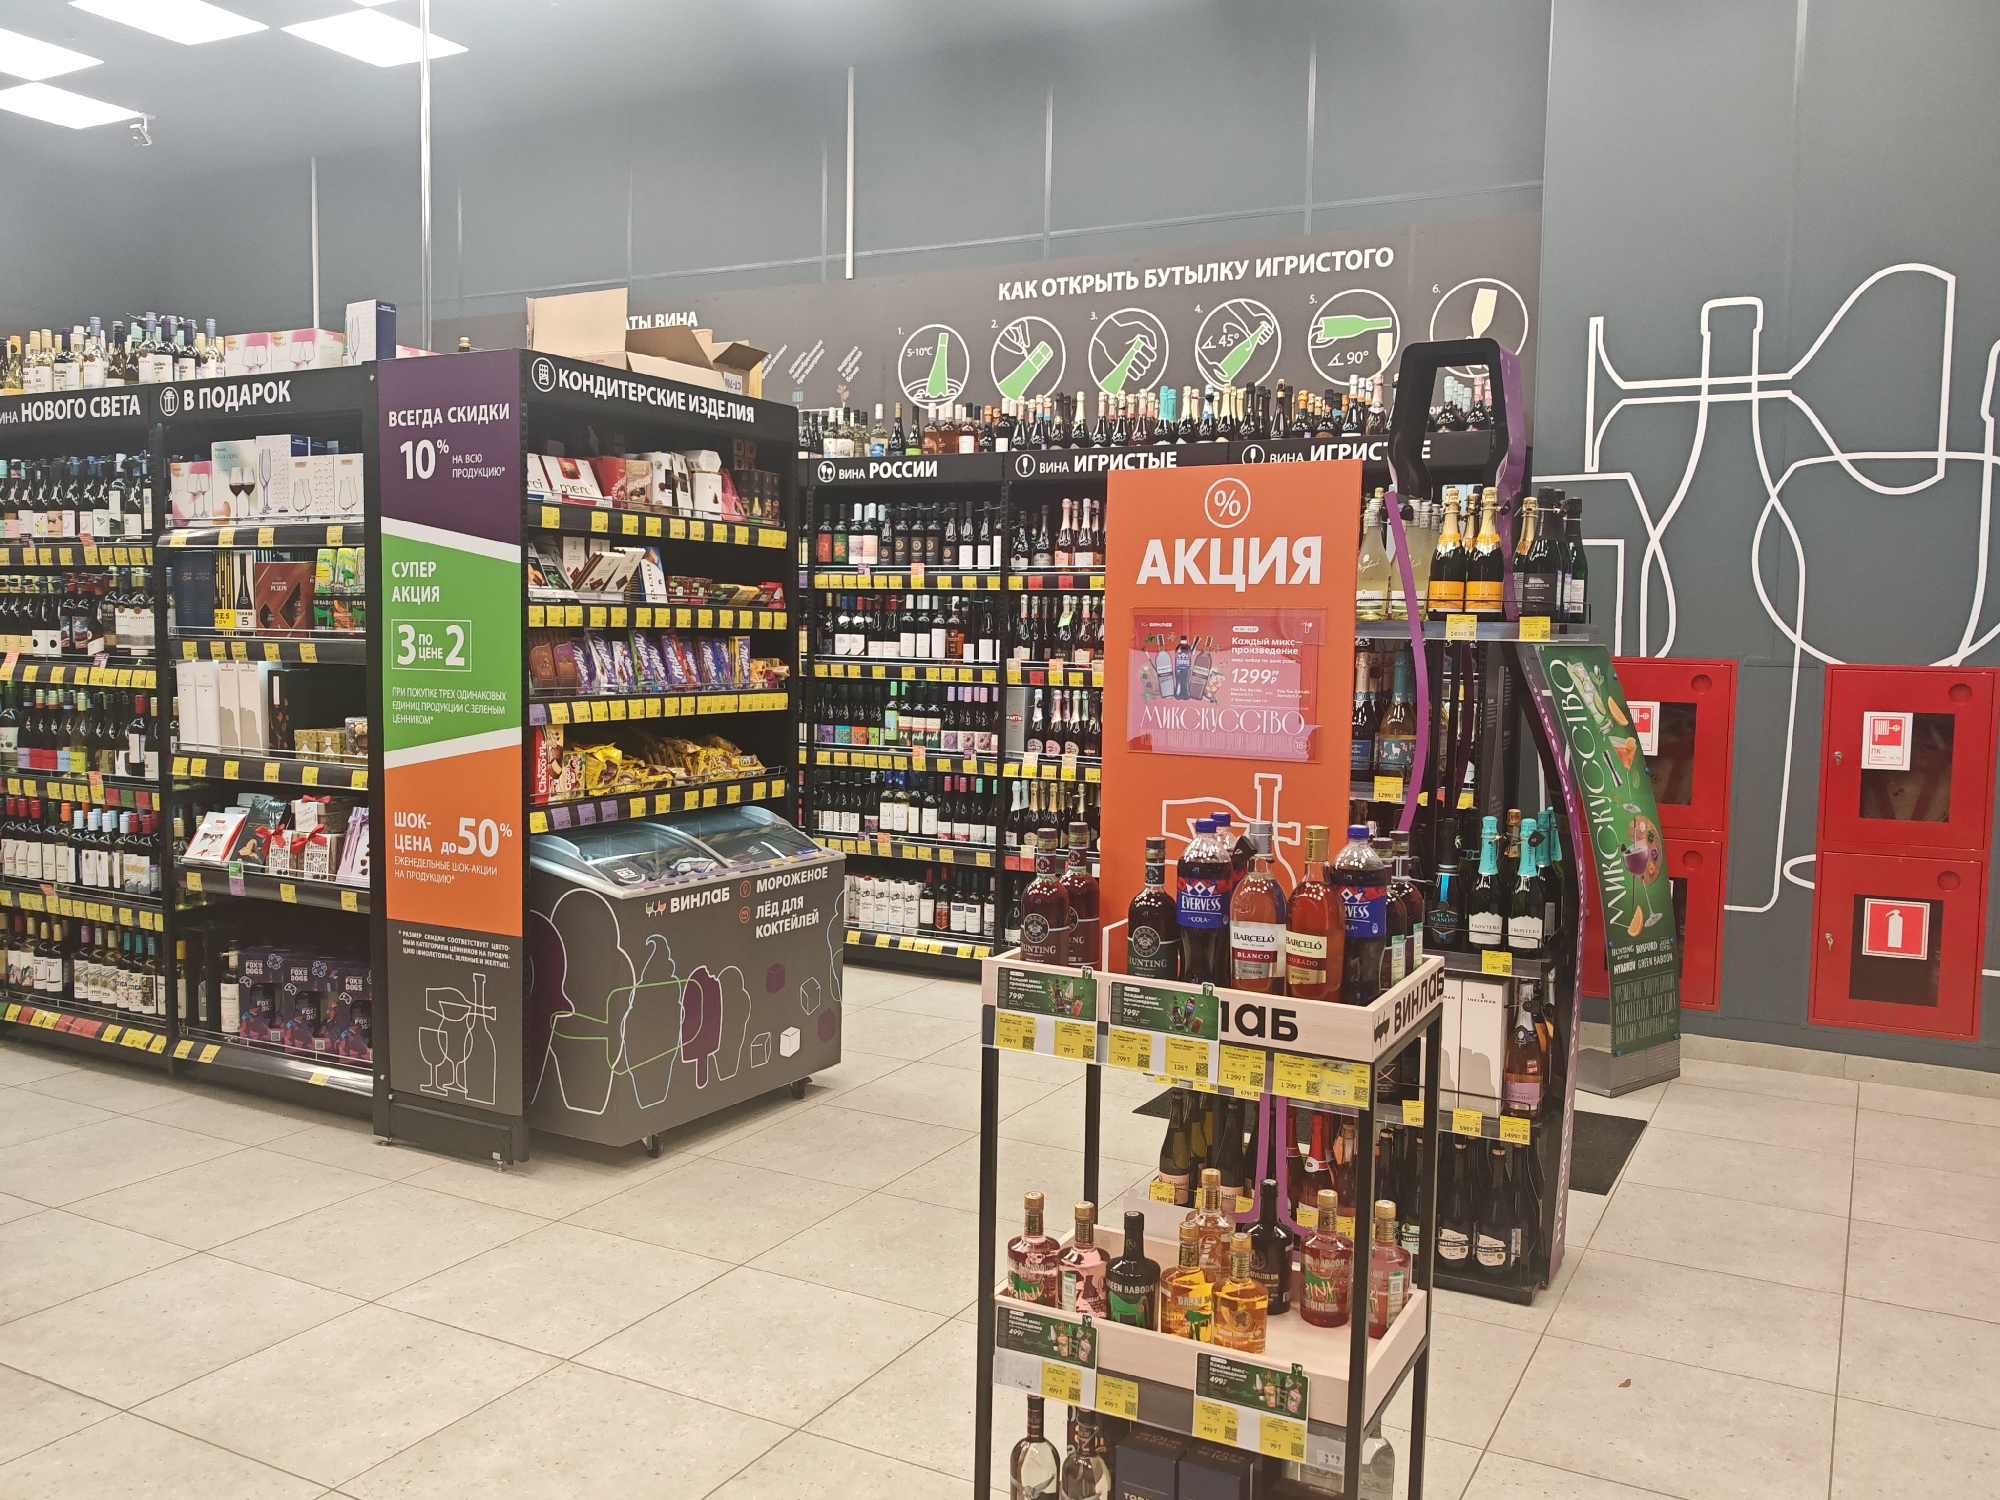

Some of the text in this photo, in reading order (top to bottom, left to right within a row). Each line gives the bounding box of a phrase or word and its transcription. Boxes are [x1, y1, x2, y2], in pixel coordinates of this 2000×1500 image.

[998, 246, 1394, 301] КАК ОТКРЫТЬ БУТЫЛКУ ИГРИСТОГО
[1432, 284, 1441, 294] 6.
[1309, 295, 1318, 304] 5.
[1090, 311, 1098, 320] 3.
[1194, 304, 1203, 314] 4.
[655, 311, 698, 328] ВИНА
[991, 320, 998, 328] 2.
[897, 327, 905, 336] 1.
[1218, 332, 1240, 348] 45°
[1346, 350, 1369, 366] 90°
[183, 379, 291, 413] В ПОДАРОК
[558, 368, 686, 412] КОНДИТЕРСКИЕ
[688, 393, 755, 424] ИЗДЕЛИЯ
[21, 399, 87, 423] НОВОГО
[90, 394, 141, 418] СВЕТА
[388, 403, 510, 429] ВСЕГДА СКИДКИ
[400, 438, 450, 480] 10%
[452, 453, 483, 464] НА ВСЮ
[1039, 451, 1178, 474] ВИНА ИГРИСТЫЕ
[1269, 452, 1304, 464] ВИНА
[838, 460, 938, 480] ВИНА РОССИИ
[391, 561, 437, 578] СУПЕР
[1136, 536, 1322, 592] АКЦИЯ
[391, 585, 440, 605] АКЦИЯ
[241, 617, 249, 626] 5
[397, 624, 465, 666] 3 ПО 2
[1232, 636, 1270, 647] Каждый
[418, 647, 443, 661] ЦЕНЕ
[1232, 647, 1298, 655] произведение
[1232, 668, 1272, 684] 1299
[392, 686, 507, 702] ПРИ ПОКУПКЕ ТРЕХ ОДИНАКОВЫХ
[392, 701, 505, 715] ЕДИНИЦ ПРОДУКЦИИ С ЗЕЛЕНЫМ
[1140, 705, 1305, 735] МИКСКУССТВО
[393, 811, 432, 829] ШОК-
[394, 816, 513, 858] ЦЕНА до 50%
[394, 855, 498, 876] ЕЖЕНЕДЕЛЬНЫЕ ШОК-АКЦИИ
[394, 869, 405, 879] НА
[756, 866, 829, 894] МОРОЖЕНОЕ
[755, 895, 804, 920] ЛЁД ДЛЯ
[1181, 895, 1221, 911] EVERVESS
[755, 908, 820, 940] КОКТЕЙЛЕЙ
[402, 930, 422, 939] РАЗМЕР
[424, 933, 446, 942] СКИДКИ
[447, 936, 489, 949] СООТВЕТСТВУЕТ
[1233, 931, 1275, 943] BARCELÓ
[416, 940, 449, 951] КАТЕГОРИЯМ
[449, 946, 478, 956] ЦЕННИКОВ
[479, 949, 487, 957] НА
[1237, 951, 1270, 960] BLANCO
[1124, 1282, 1155, 1295] BABOON
